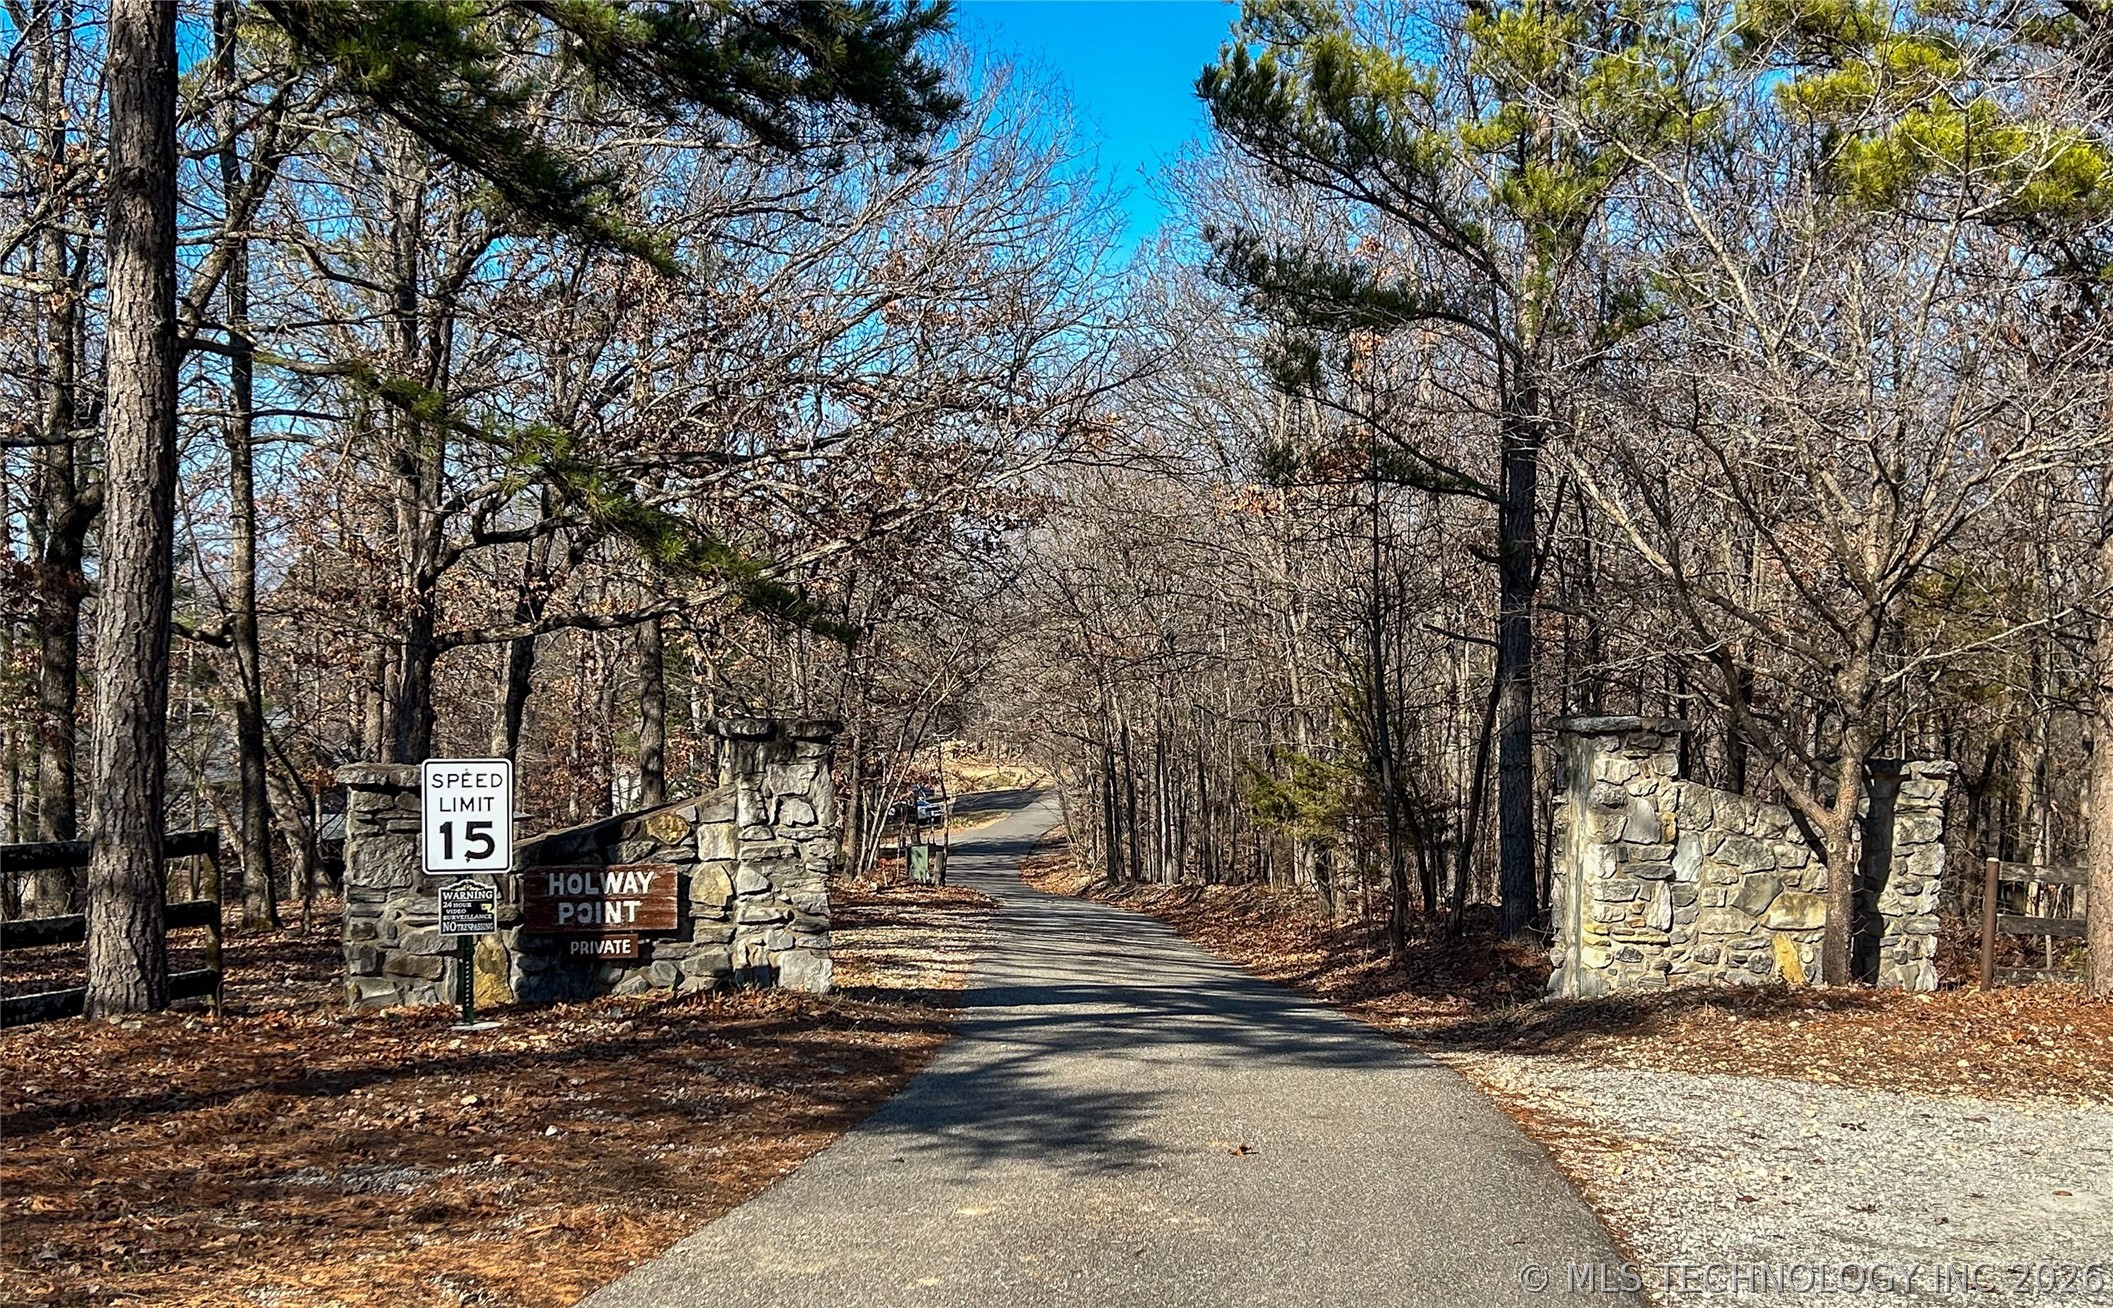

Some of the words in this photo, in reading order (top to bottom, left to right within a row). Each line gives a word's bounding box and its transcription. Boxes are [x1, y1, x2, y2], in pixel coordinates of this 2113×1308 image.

[431, 773, 503, 789] SPEED
[439, 797, 495, 812] LIMIT
[439, 820, 495, 861] 15
[548, 871, 655, 895] HOLWAY
[442, 890, 493, 900] WARNING
[558, 900, 641, 925] POINT
[442, 921, 457, 932] NO
[570, 939, 631, 955] PRIVATE
